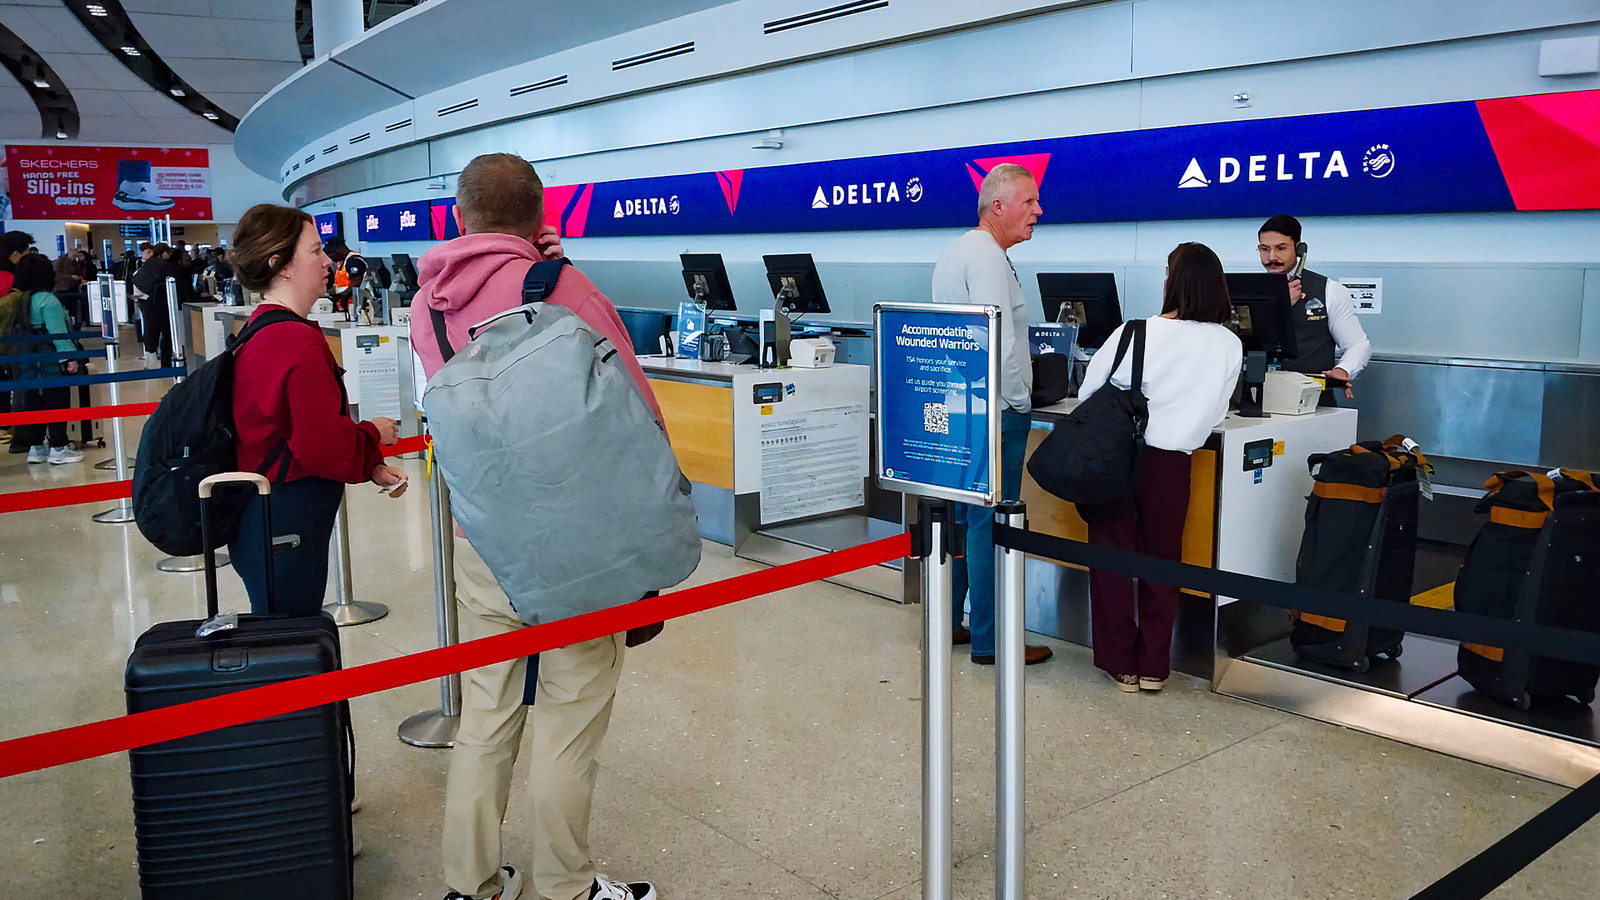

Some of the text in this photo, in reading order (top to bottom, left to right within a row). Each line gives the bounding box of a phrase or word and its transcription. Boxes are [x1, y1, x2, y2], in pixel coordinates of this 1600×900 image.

[20, 159, 99, 169] SKECHERS
[1219, 150, 1350, 183] DELTA
[27, 179, 95, 198] Slip-ins
[833, 181, 900, 206] DELTA
[625, 197, 667, 216] DELTA
[901, 323, 973, 339] Accommodating
[895, 335, 980, 351] Wounded Warriors
[916, 356, 934, 364] honors
[947, 359, 967, 367] service
